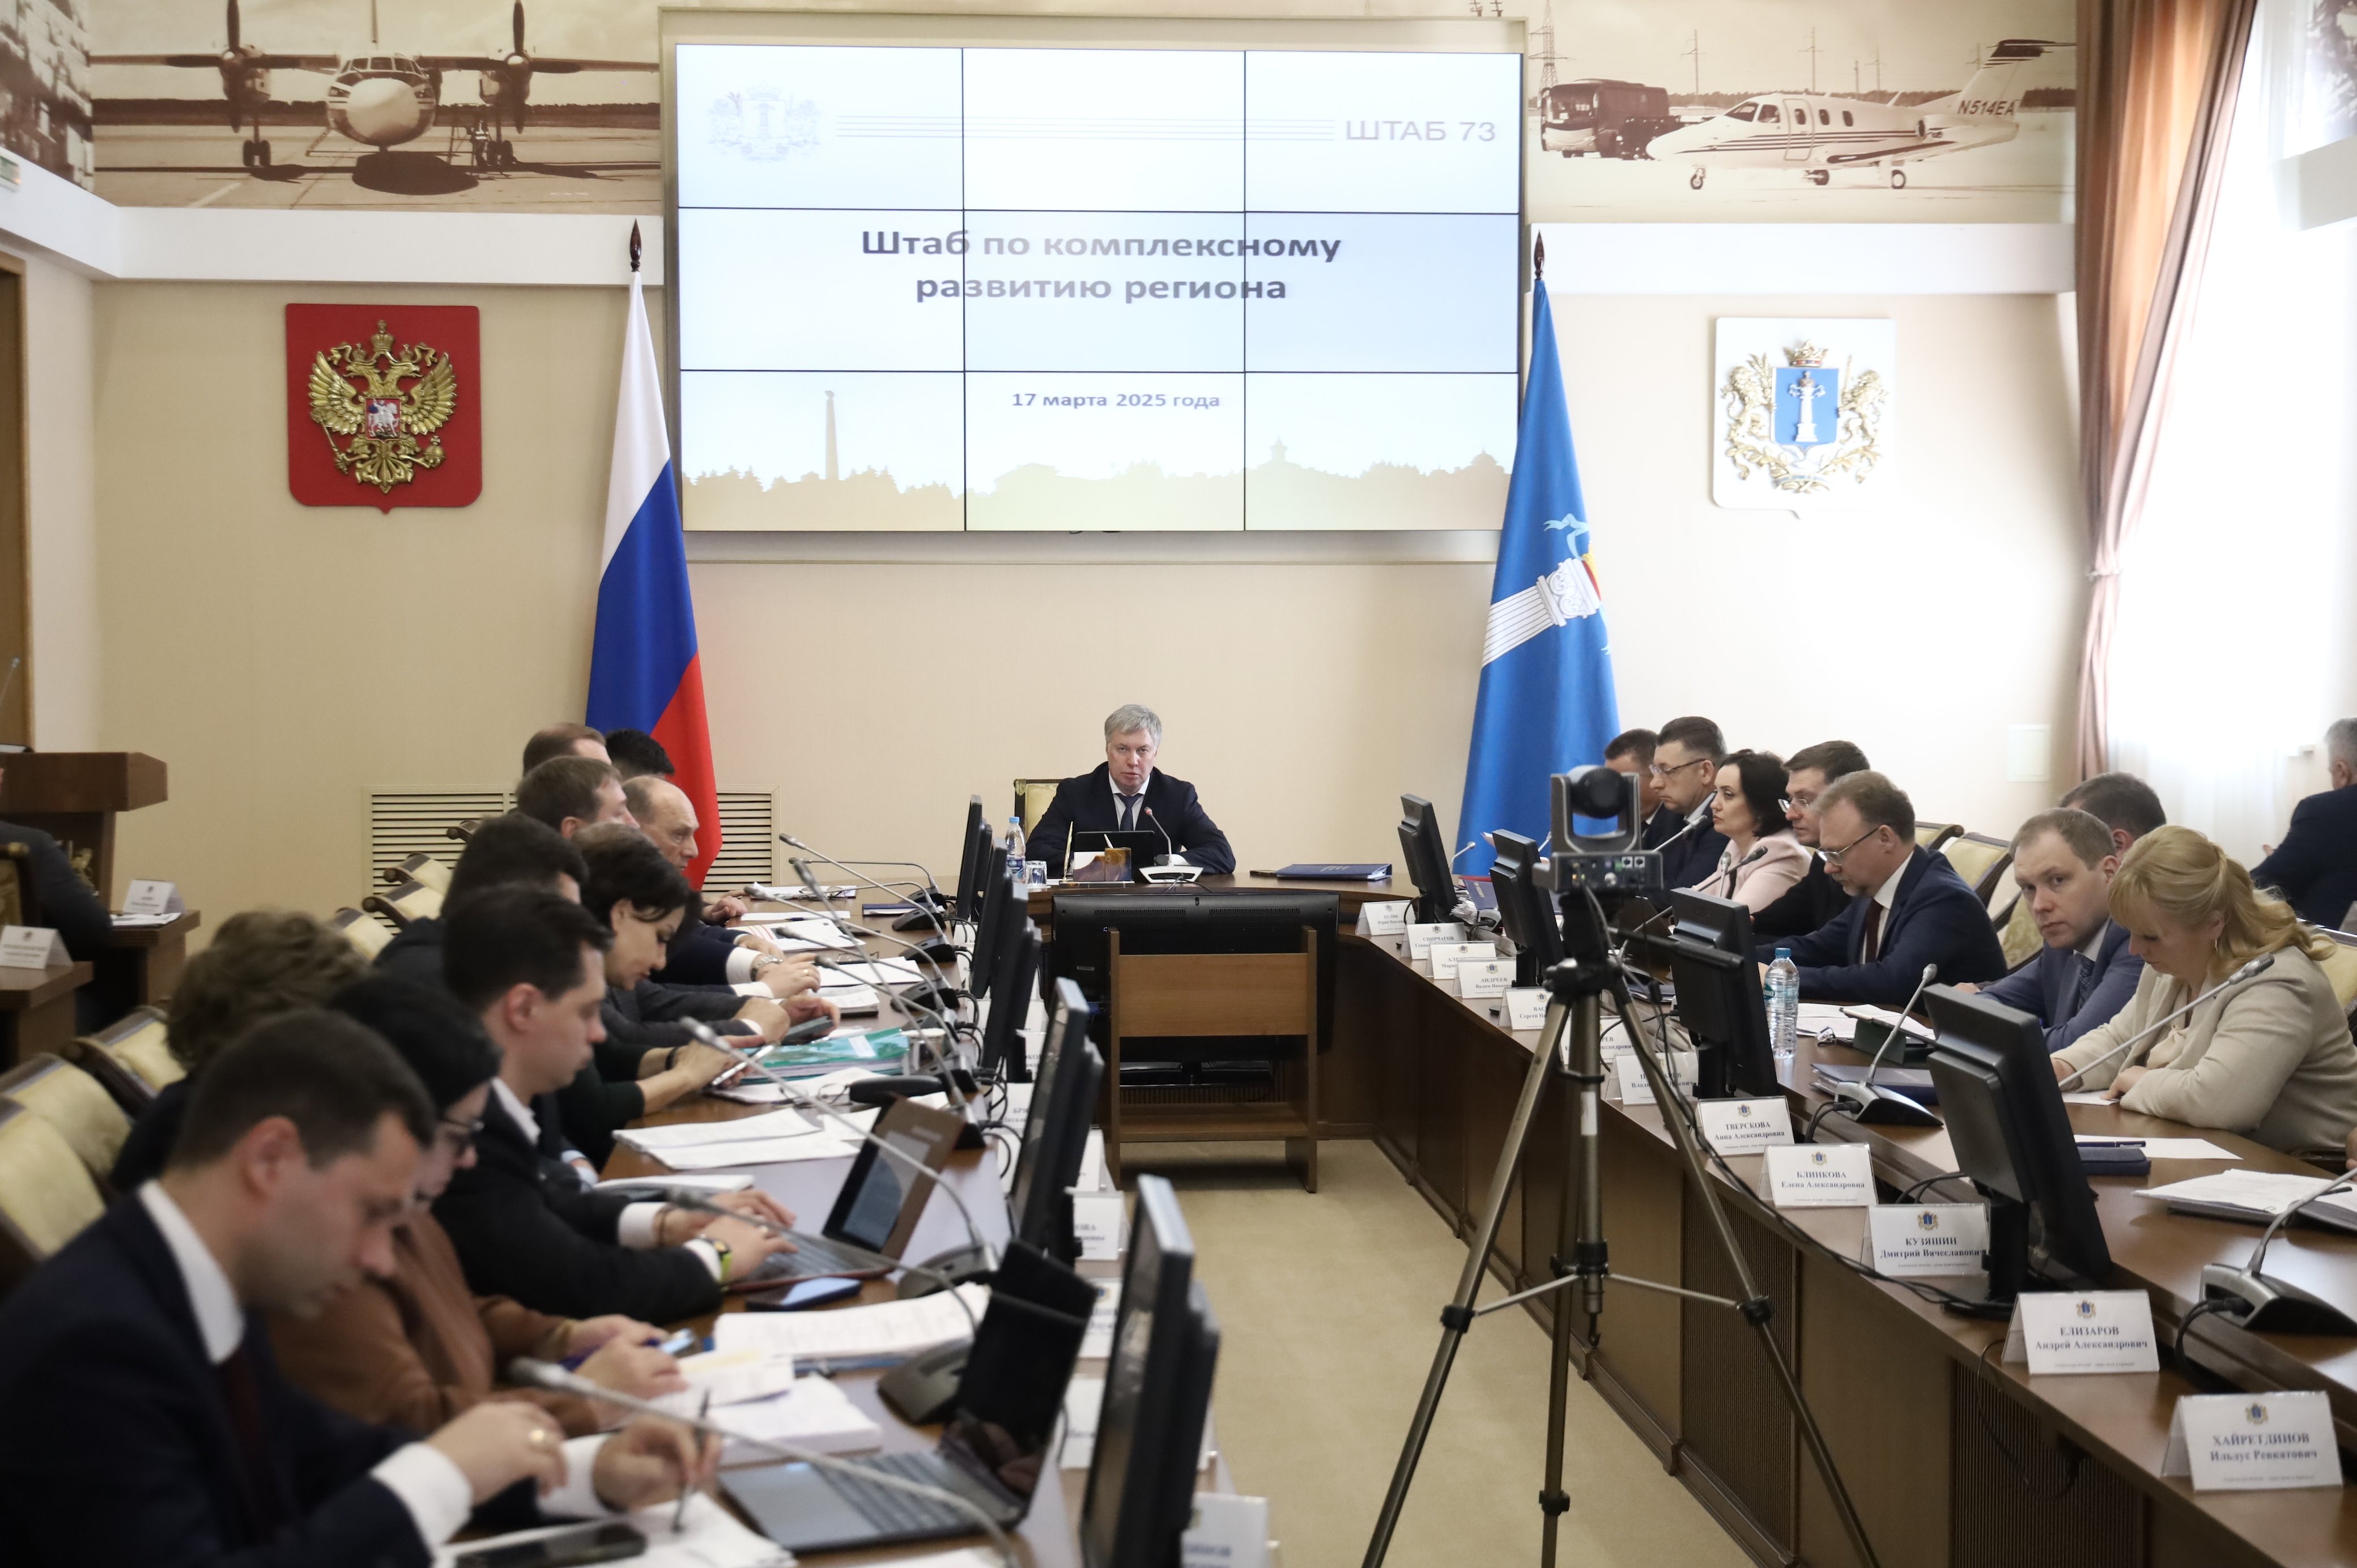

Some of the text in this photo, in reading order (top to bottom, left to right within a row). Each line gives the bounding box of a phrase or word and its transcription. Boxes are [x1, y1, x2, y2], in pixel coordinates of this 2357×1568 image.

[1957, 100, 2015, 116] N514EA
[1346, 120, 1496, 142] ШТАБ 73
[862, 229, 1341, 263] Штаб по комплексному
[917, 279, 1286, 304] развитию региона
[1012, 393, 1220, 410] 17 марта 2025 года
[1725, 1122, 1771, 1130] ТВЕРСКОВА
[1734, 1131, 1785, 1140] Александровна
[1905, 1237, 1957, 1246] КУЗЯШИН
[1880, 1249, 1920, 1259] Дмитрий
[2060, 1326, 2120, 1336] ЕЛИЗАРОВ
[2035, 1340, 2147, 1352] Андрей Александрович
[2213, 1433, 2309, 1446] ХАЙРЕТДИНОВ
